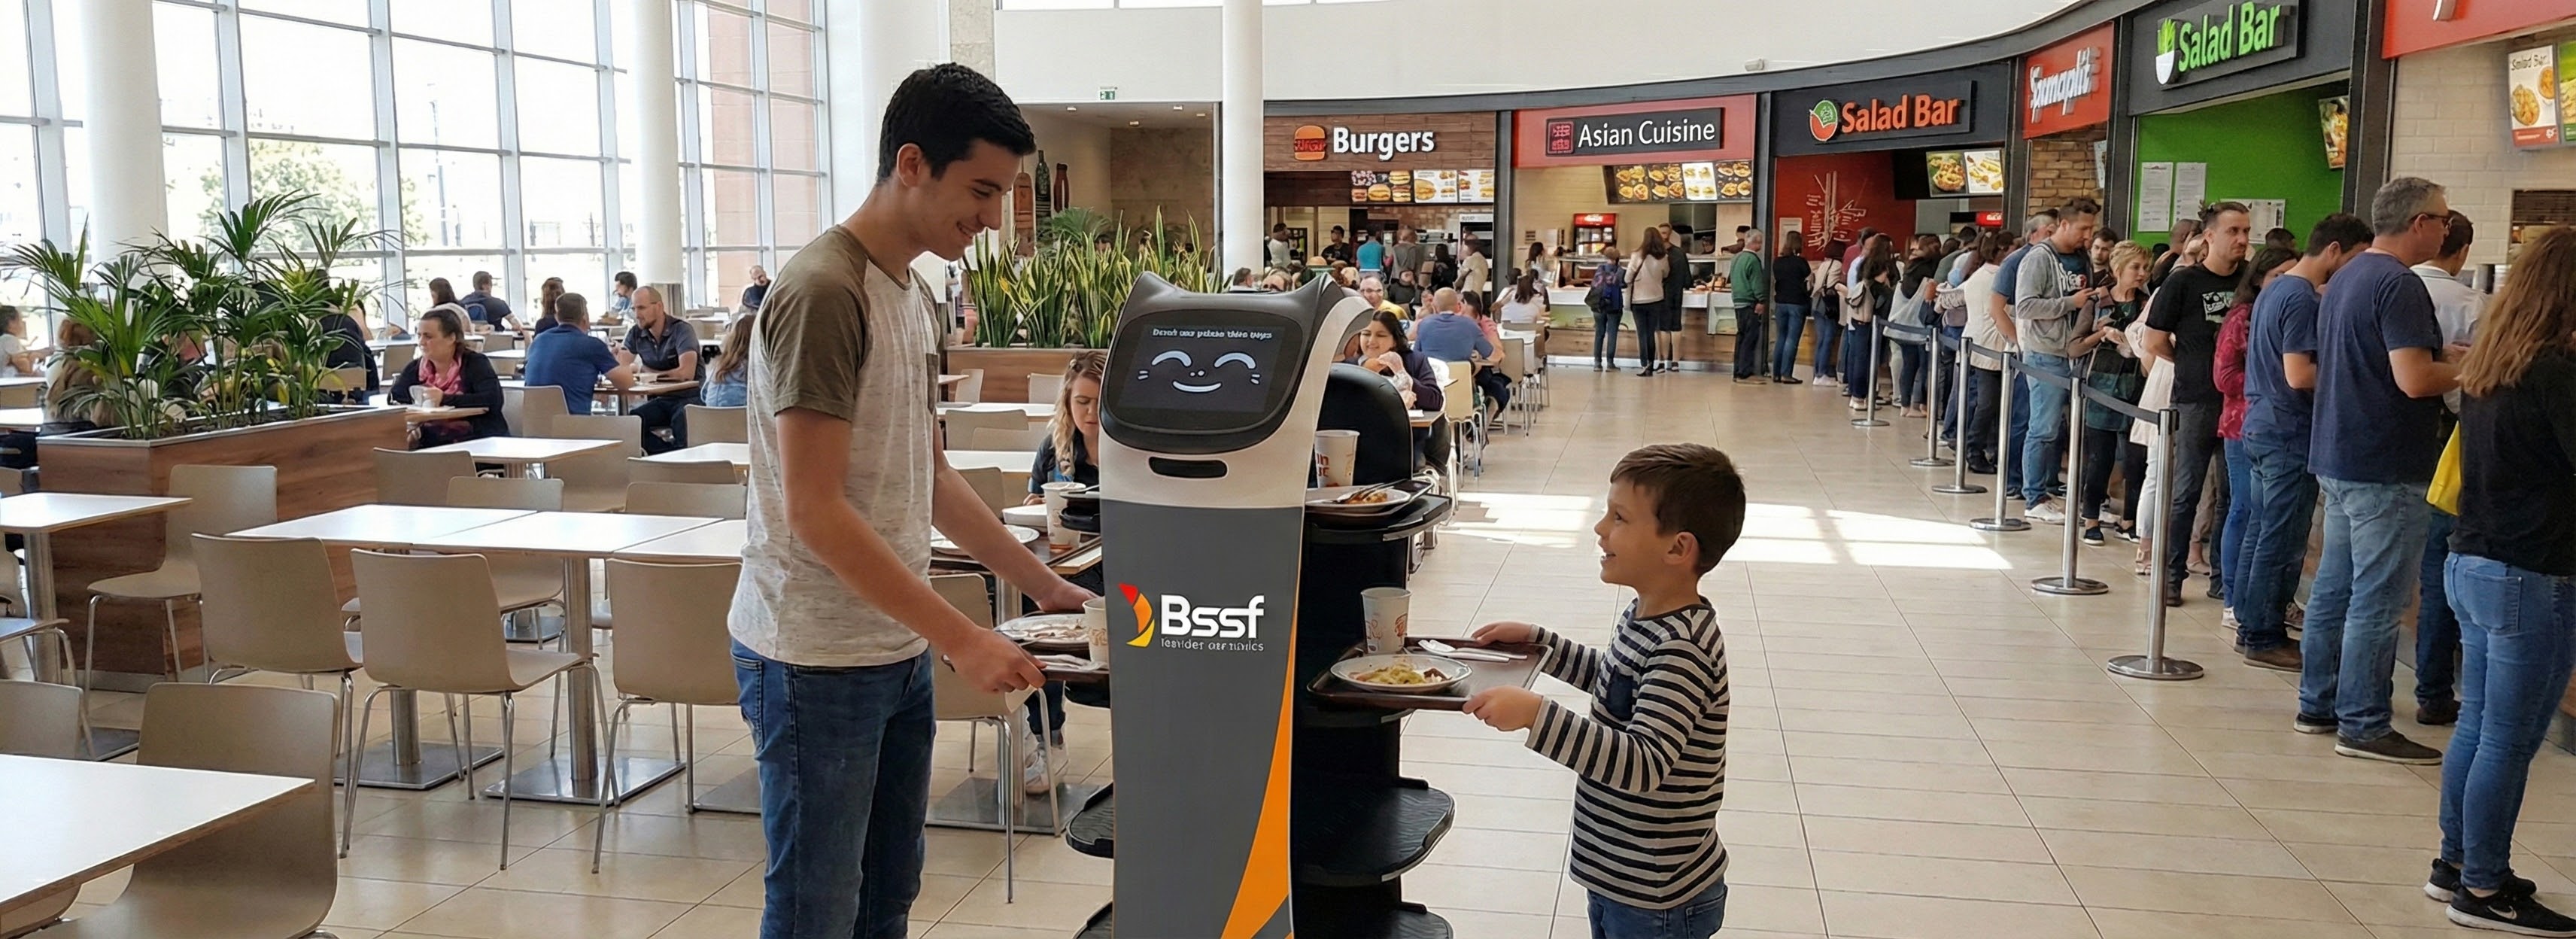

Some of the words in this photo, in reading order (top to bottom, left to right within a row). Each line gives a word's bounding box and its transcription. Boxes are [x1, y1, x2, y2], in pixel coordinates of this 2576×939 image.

[2179, 4, 2234, 71] Salad
[2238, 2, 2281, 56] Bar
[1578, 123, 1633, 148] Asian
[1639, 118, 1715, 144] Cuisine
[1842, 94, 1908, 133] Salad
[1914, 94, 1959, 127] Bar
[1333, 127, 1435, 161] Burgers
[1161, 594, 1265, 639] Bssf
